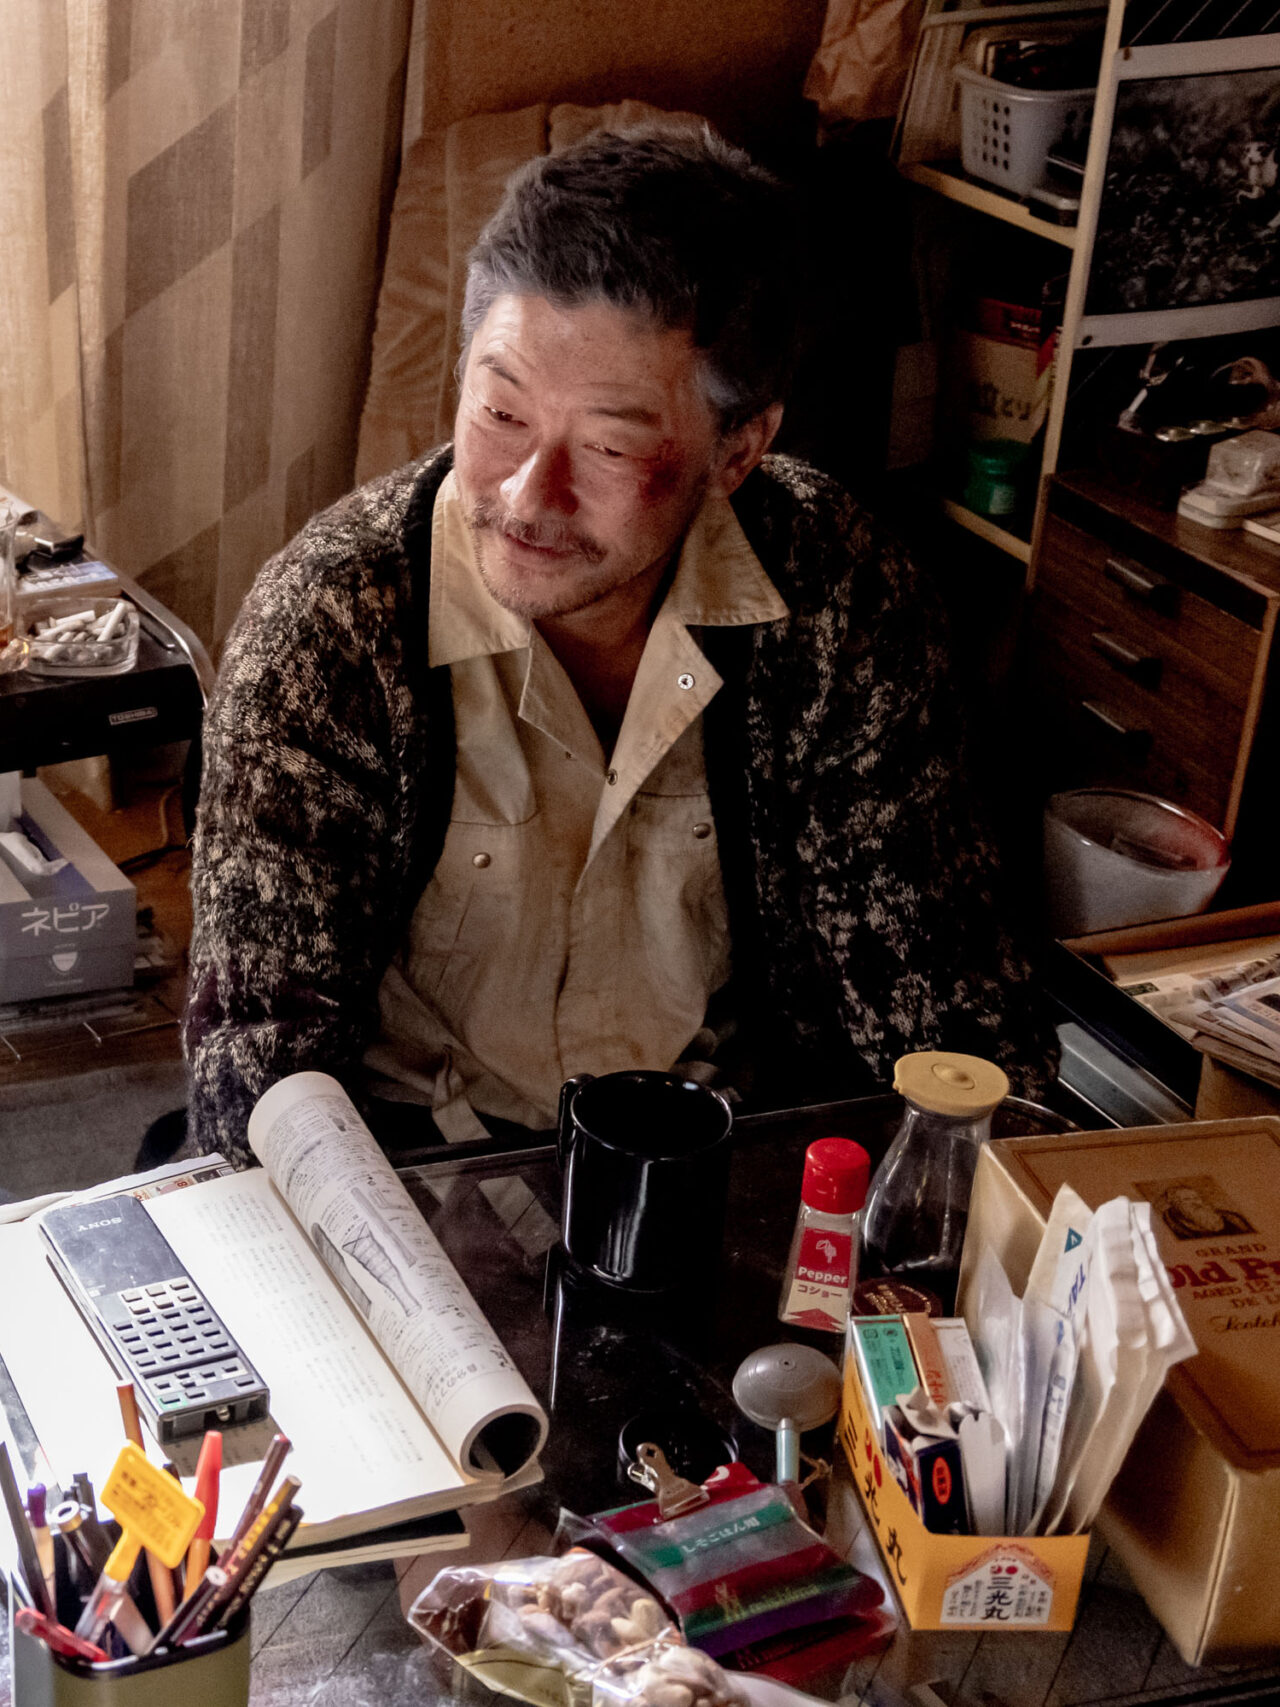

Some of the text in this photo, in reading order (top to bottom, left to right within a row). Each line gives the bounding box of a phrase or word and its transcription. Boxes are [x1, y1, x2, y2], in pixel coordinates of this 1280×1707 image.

[21, 902, 110, 936] ネピア
[78, 1217, 122, 1232] SONY
[1195, 1242, 1267, 1258] GRAND
[797, 1265, 848, 1285] Pepper
[797, 1284, 843, 1298] コショー
[844, 1410, 908, 1587] 三光丸
[981, 1575, 1015, 1621] 三光丸
